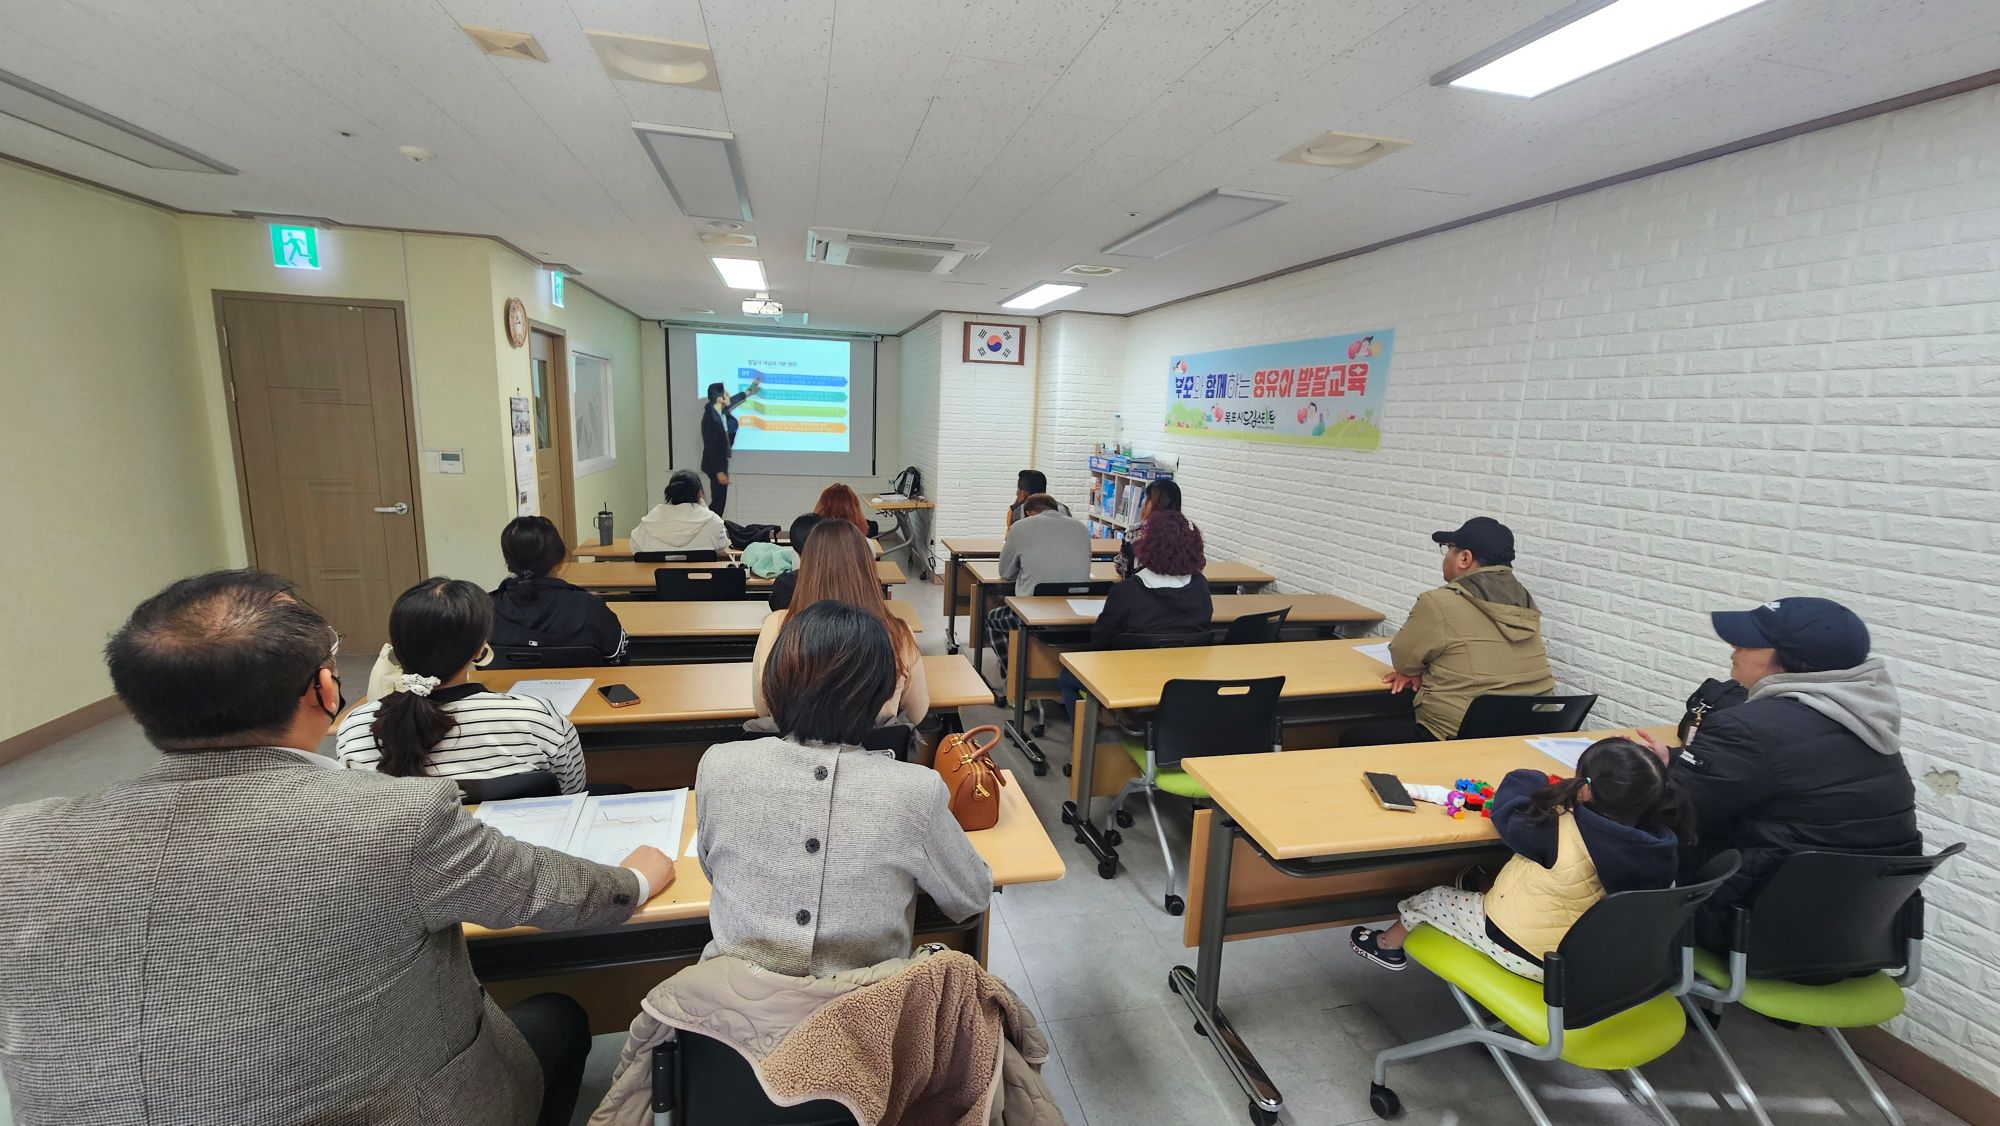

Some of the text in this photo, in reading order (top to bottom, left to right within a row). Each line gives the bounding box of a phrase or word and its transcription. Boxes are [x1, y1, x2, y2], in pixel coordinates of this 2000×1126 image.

[1175, 363, 1369, 399] 부모와 함께하는 영유아 발달교육
